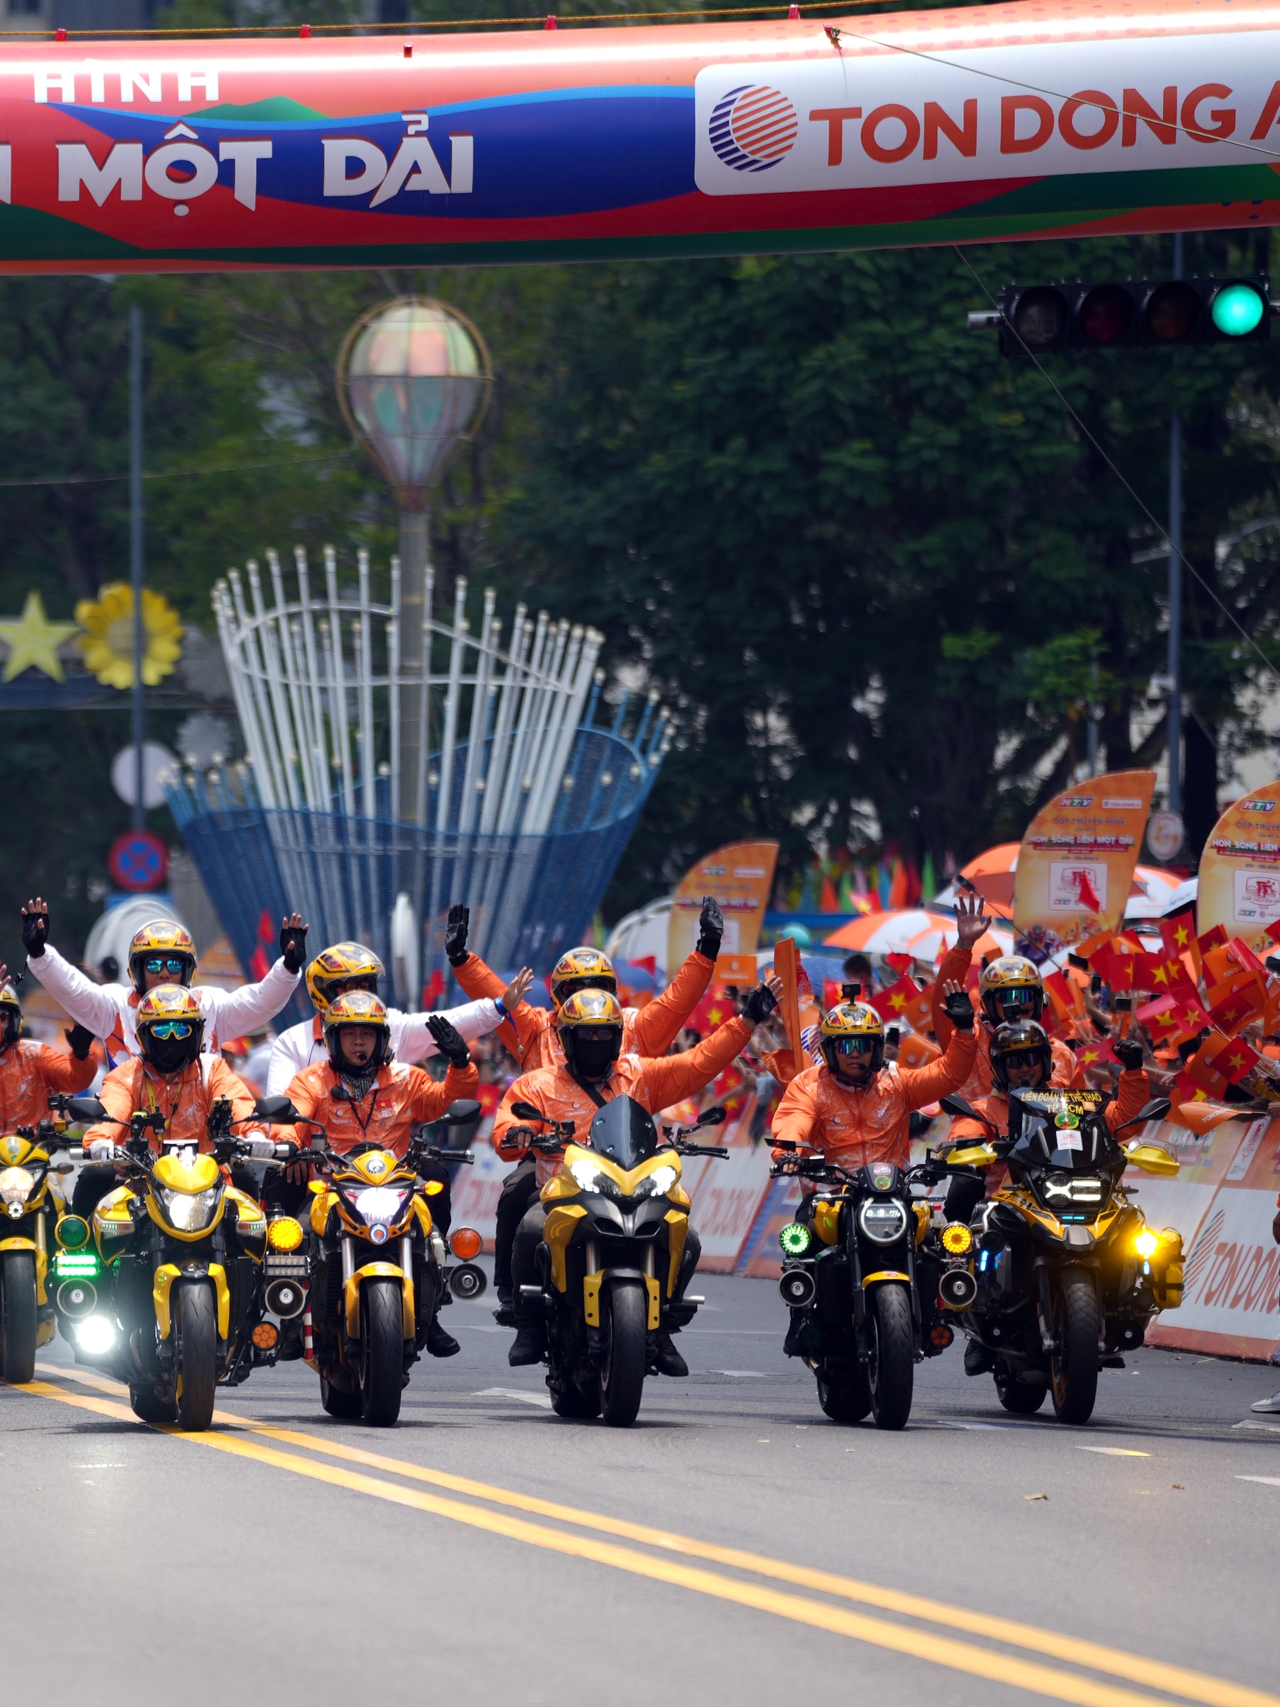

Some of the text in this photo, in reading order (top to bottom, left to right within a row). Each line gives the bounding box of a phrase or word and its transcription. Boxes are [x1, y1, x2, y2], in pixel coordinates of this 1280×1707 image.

[808, 98, 978, 167] TON
[1000, 82, 1237, 155] DONG
[55, 123, 273, 217] MỘT
[321, 113, 474, 209] DẢI
[1060, 798, 1092, 808] HTV
[1242, 801, 1275, 812] HTV
[1212, 839, 1231, 848] NON
[1194, 1241, 1253, 1308] TON
